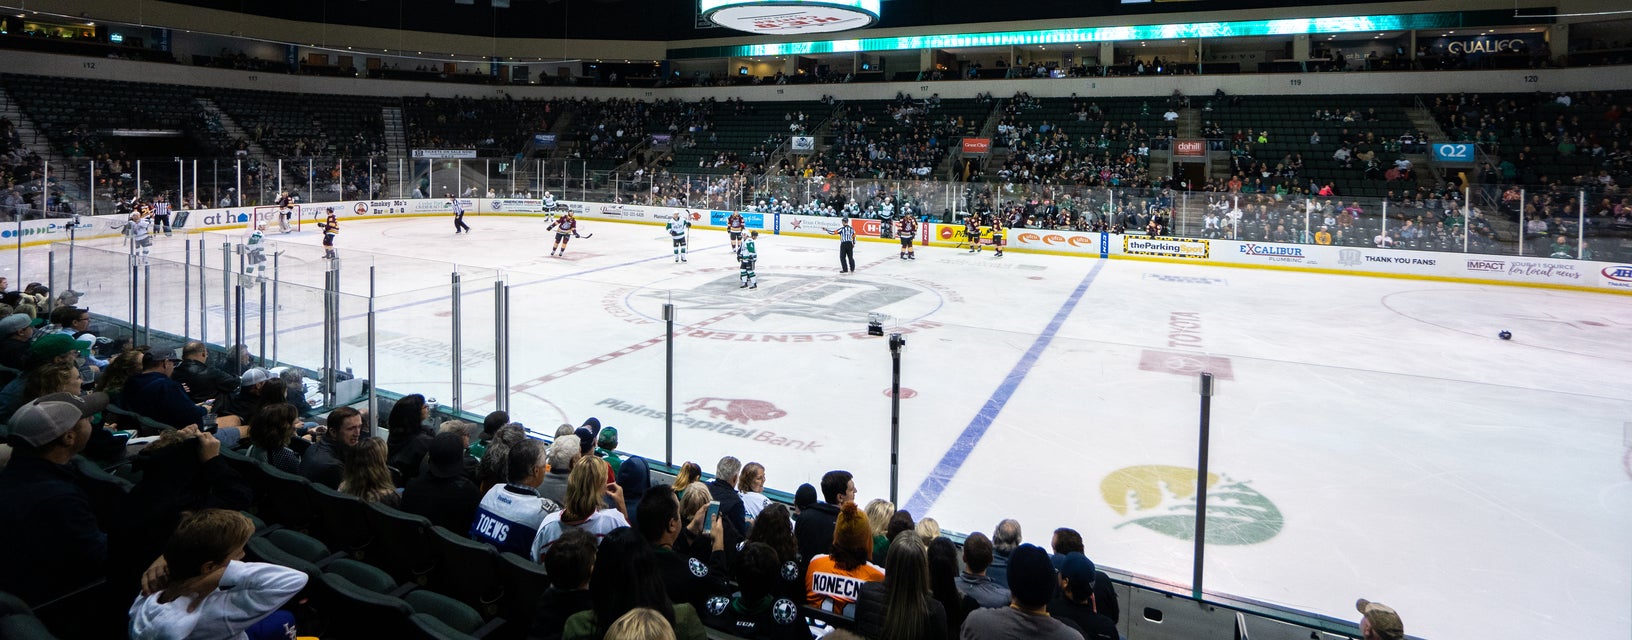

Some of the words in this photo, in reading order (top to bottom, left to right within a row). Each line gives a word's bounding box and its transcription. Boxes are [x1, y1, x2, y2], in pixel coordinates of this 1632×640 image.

[1524, 75, 1538, 83] 120
[976, 141, 988, 149] Clips
[1177, 142, 1200, 151] dahill
[1440, 144, 1467, 157] Q2
[204, 212, 221, 225] at
[1240, 243, 1302, 256] EXCALIBUR
[1365, 255, 1392, 263] THANK
[1412, 258, 1436, 266] FANS!
[1467, 261, 1505, 270] IMPACT
[1508, 264, 1525, 276] for
[1526, 264, 1553, 278] local
[1555, 269, 1581, 279] news
[1168, 311, 1203, 348] TOYOTA
[687, 329, 841, 343] CENTER
[497, 494, 513, 505] Reebok
[476, 513, 510, 542] TOEWS
[736, 620, 756, 628] CCM
